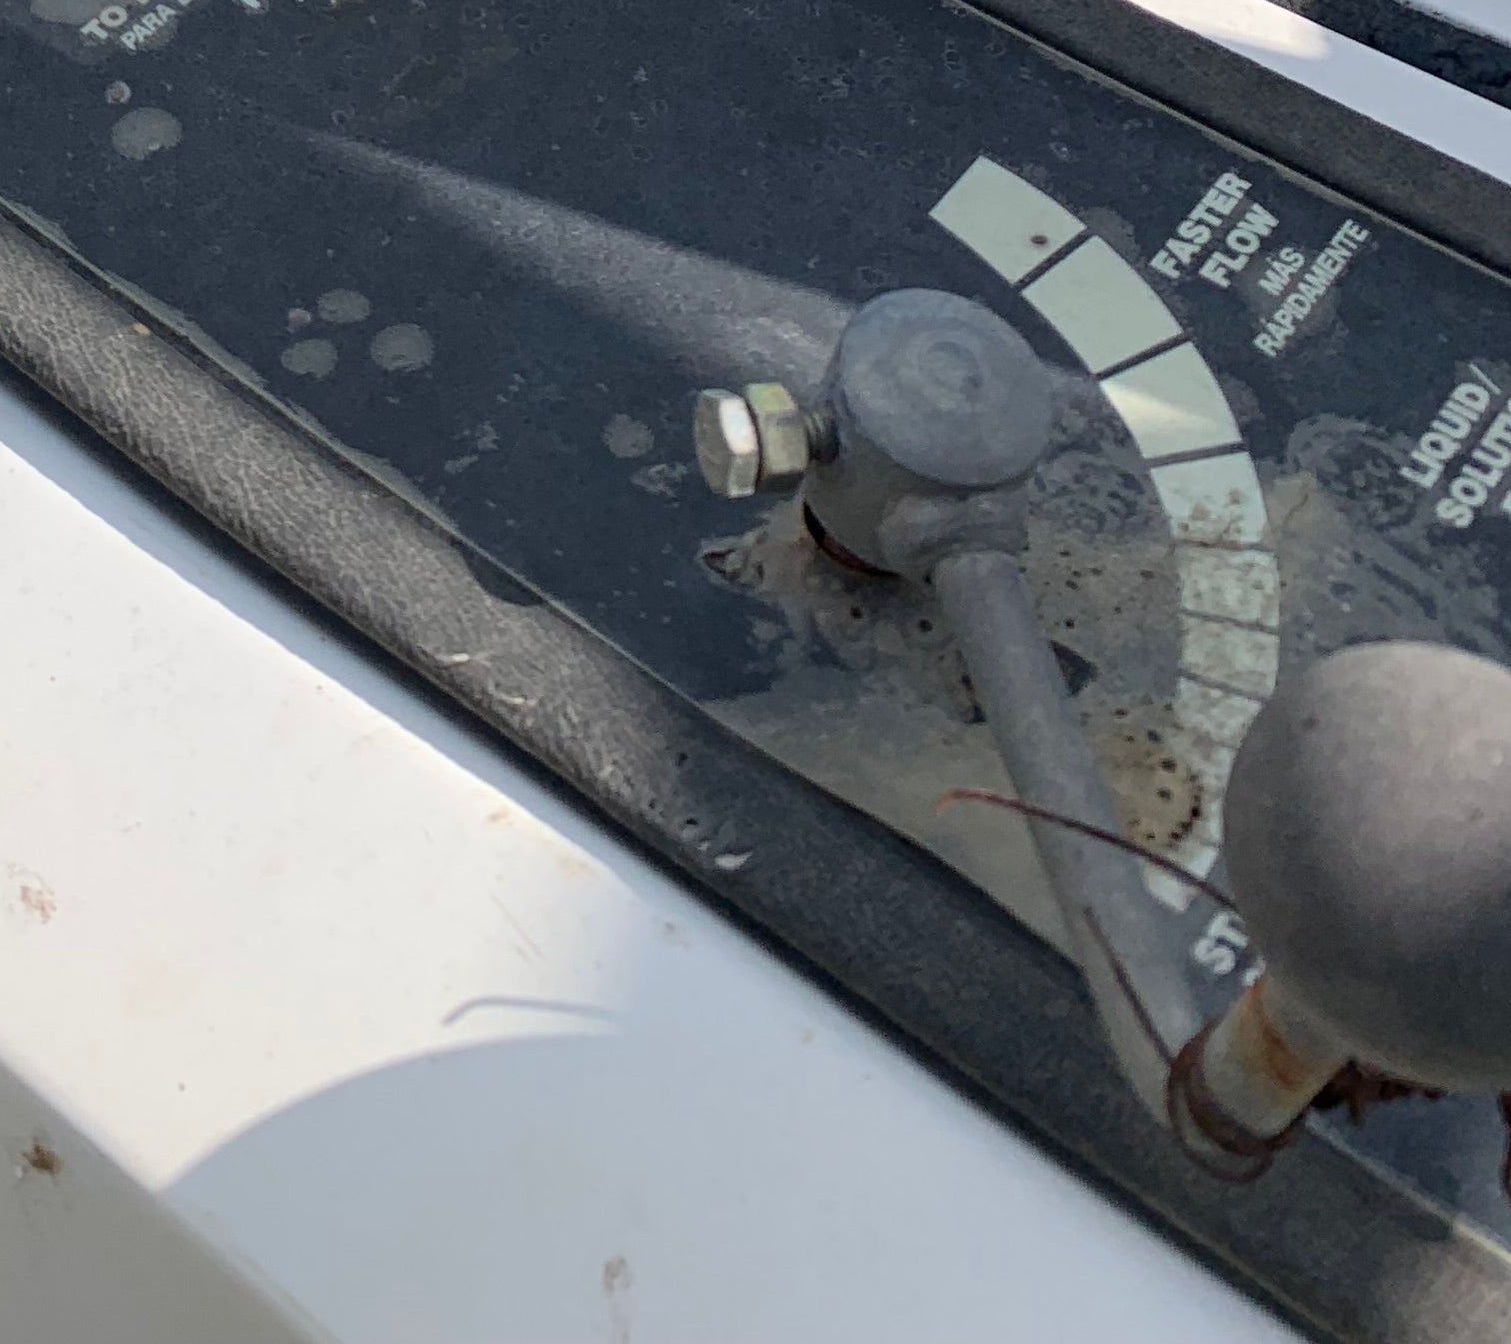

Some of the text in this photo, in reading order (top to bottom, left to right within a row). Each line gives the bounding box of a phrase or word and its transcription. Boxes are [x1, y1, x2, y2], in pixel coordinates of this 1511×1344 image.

[79, 4, 129, 41] TO
[119, 2, 177, 51] PARA
[1149, 171, 1253, 279] FASTER
[1198, 202, 1280, 289] FLOW
[1252, 218, 1372, 359] RÁPIDAMENTE
[1258, 246, 1306, 297] MÁS
